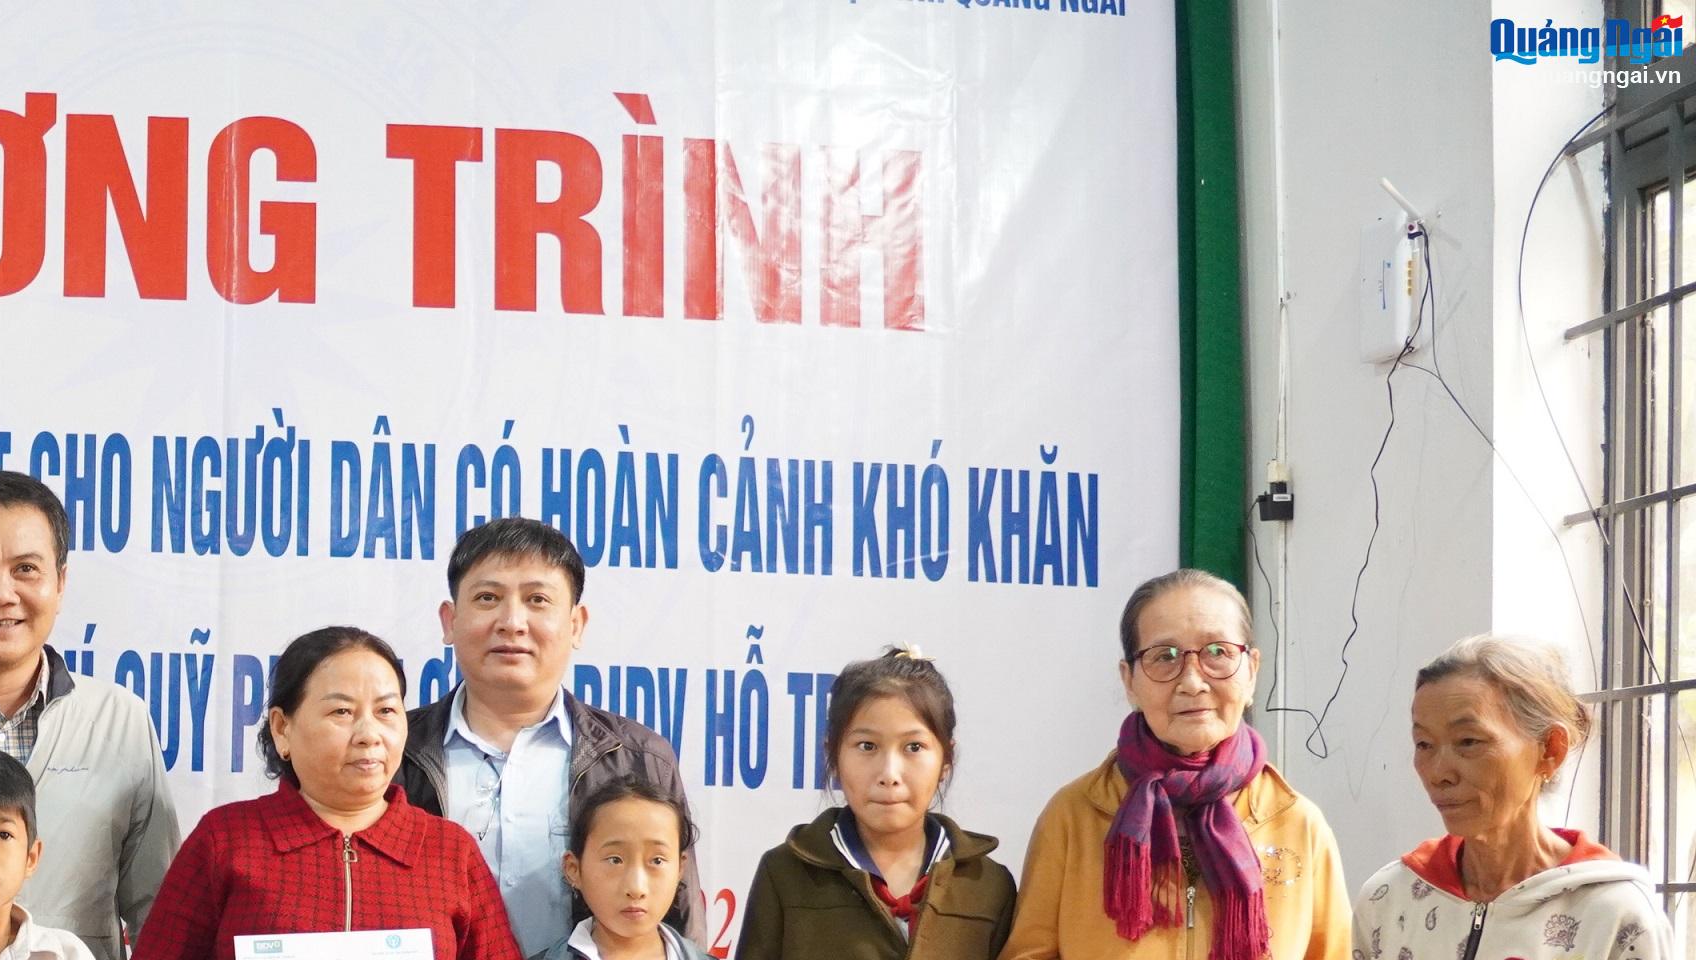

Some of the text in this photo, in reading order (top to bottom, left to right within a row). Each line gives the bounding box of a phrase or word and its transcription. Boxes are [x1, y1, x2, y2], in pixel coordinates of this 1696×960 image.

[386, 91, 926, 331] TRÌNH
[30, 433, 133, 556] CHO
[151, 407, 311, 559] NGƯỜI
[330, 415, 437, 561] DÂN
[541, 423, 679, 570] HOÀN
[703, 414, 834, 576] CẢNH
[851, 438, 948, 583] KHÓ
[966, 444, 1100, 590] KHĂN
[704, 624, 770, 790] HỖ
